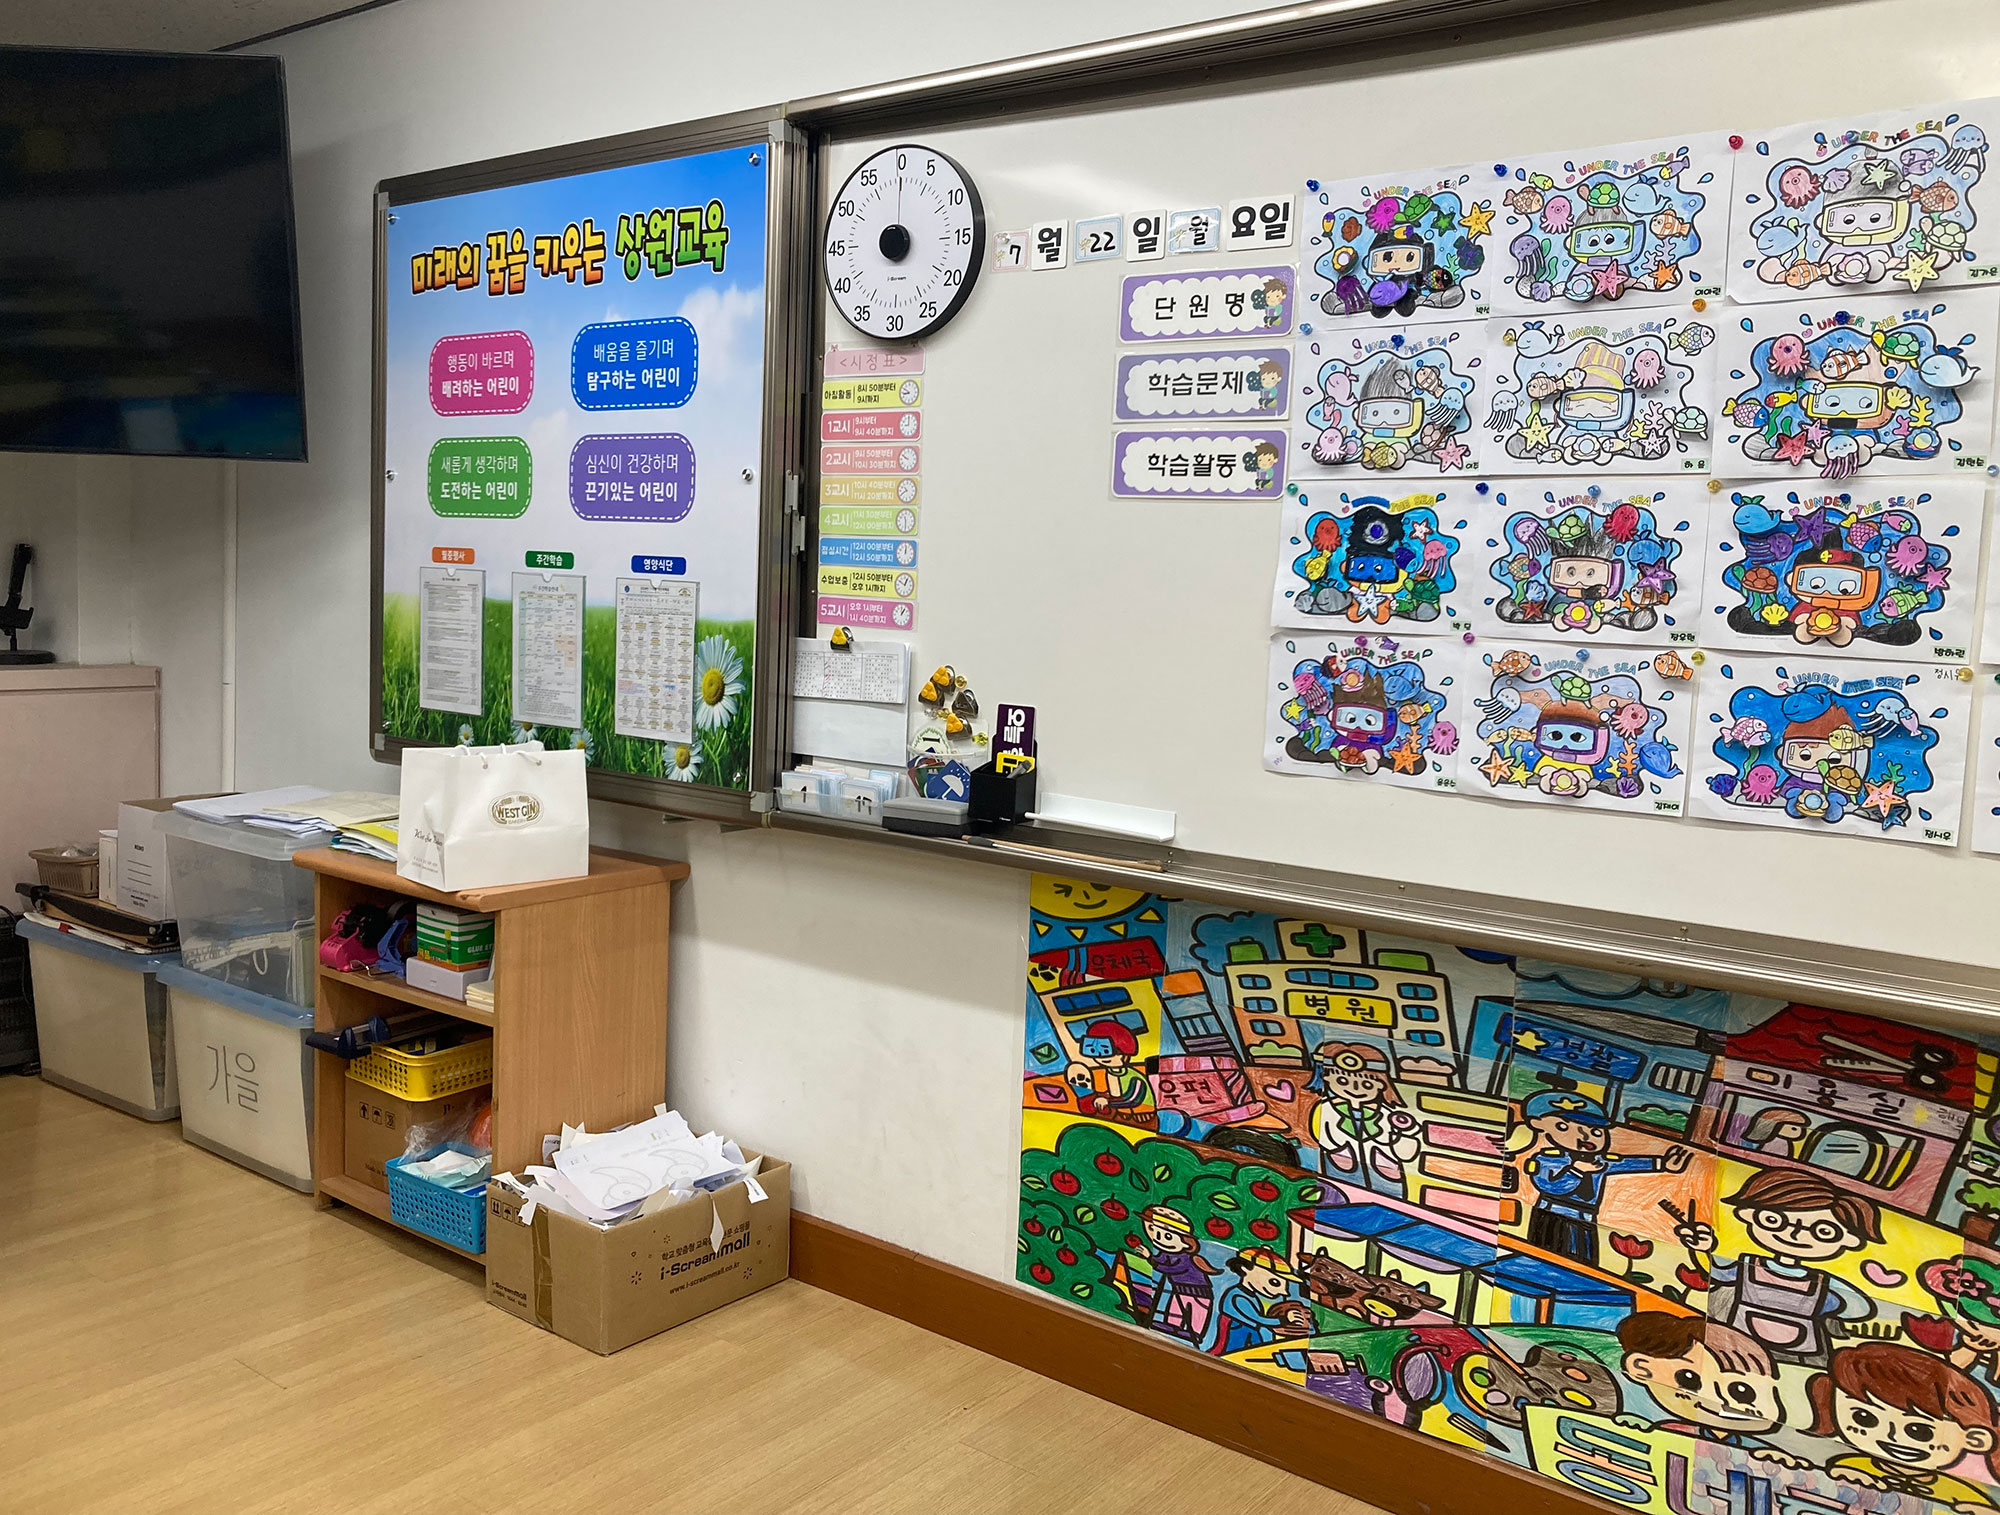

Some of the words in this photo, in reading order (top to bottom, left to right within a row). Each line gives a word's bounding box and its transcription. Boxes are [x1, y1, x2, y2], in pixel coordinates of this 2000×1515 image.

[1831, 130, 1879, 148] UNER
[1884, 128, 1910, 146] THE
[1916, 120, 1942, 133] SEA
[898, 154, 906, 170] 0
[926, 159, 936, 176] 5
[1579, 158, 1619, 176] UNDER
[1622, 158, 1646, 174] THE
[1650, 152, 1674, 166] SEA
[860, 169, 878, 186] 55
[948, 188, 964, 206] 10
[1374, 186, 1410, 200] UNDER
[1436, 180, 1457, 190] SEA
[838, 200, 854, 216] 50
[954, 228, 972, 246] 15
[1010, 244, 1020, 264] 7
[1037, 227, 1062, 263] 월
[1090, 232, 1116, 252] 22
[1132, 216, 1160, 254] 일
[1189, 216, 1208, 246] 월
[1232, 202, 1290, 241] 요일
[411, 241, 481, 295] 미래의
[486, 228, 529, 296] 꿈을
[534, 218, 606, 286] 키우는
[615, 199, 729, 281] 상원교육
[828, 240, 846, 256] 45
[944, 269, 962, 286] 20
[1969, 267, 1998, 278] 김가은
[834, 278, 851, 294] 40
[854, 304, 871, 322] 35
[919, 301, 938, 318] 25
[886, 315, 904, 332] 30
[1816, 314, 1865, 330] UNER
[1870, 316, 1898, 330] THE
[1902, 309, 1929, 322] SEA
[1568, 326, 1608, 340] UNDER
[1612, 326, 1635, 342] THE
[1636, 322, 1662, 336] SEA
[593, 340, 632, 364] 배움을
[635, 338, 674, 362] 즐기며
[1404, 341, 1424, 355] THE
[1427, 336, 1448, 348] SEA
[447, 352, 478, 374] 행동이
[481, 350, 515, 370] 바르며
[442, 378, 484, 398] 배려하는
[486, 376, 520, 396] 어린이
[586, 370, 638, 392] 탐구하는
[642, 366, 680, 388] 어린이
[1148, 370, 1244, 396] 학습문제
[824, 390, 852, 400] 아침활동
[828, 420, 850, 434] 1교시
[440, 456, 473, 475] 새롭게
[474, 454, 519, 474] 생각하며
[585, 454, 622, 476] 심신이
[626, 453, 680, 475] 건강하며
[826, 452, 851, 466] 2교시
[1147, 453, 1237, 478] 학습활동
[440, 482, 482, 502] 도전하는
[484, 481, 519, 501] 어린이
[584, 482, 636, 503] 끈기있는
[639, 482, 678, 502] 어린이
[825, 484, 850, 497] 3교시
[1559, 495, 1598, 508] UNDER
[1629, 495, 1652, 506] SEA
[1856, 501, 1882, 515] THE
[1888, 496, 1914, 510] SEA
[824, 513, 850, 526] 4교시
[821, 545, 850, 556] 점심시간
[536, 554, 564, 566] 주간학습
[644, 558, 674, 572] 영양식단
[852, 572, 866, 580] 12시
[820, 604, 846, 617] 5교시
[1340, 647, 1375, 659] UNDER
[1378, 652, 1397, 664] THE
[1402, 650, 1420, 662] SEA
[1544, 661, 1584, 674] UNDER
[1588, 664, 1610, 678] THE
[1612, 662, 1637, 675] SEA
[1792, 672, 1840, 688] UNDER
[1876, 676, 1904, 690] SEA
[800, 786, 808, 804] 1
[496, 806, 520, 818] WEST
[1305, 994, 1375, 1020] 병원
[1558, 1035, 1622, 1074] 경찰
[206, 1044, 260, 1112] 가을
[1158, 1080, 1212, 1107] 우편
[662, 1248, 675, 1260] 학교
[676, 1242, 695, 1257] 맞춤형
[734, 1220, 750, 1234] 쇼핑몰
